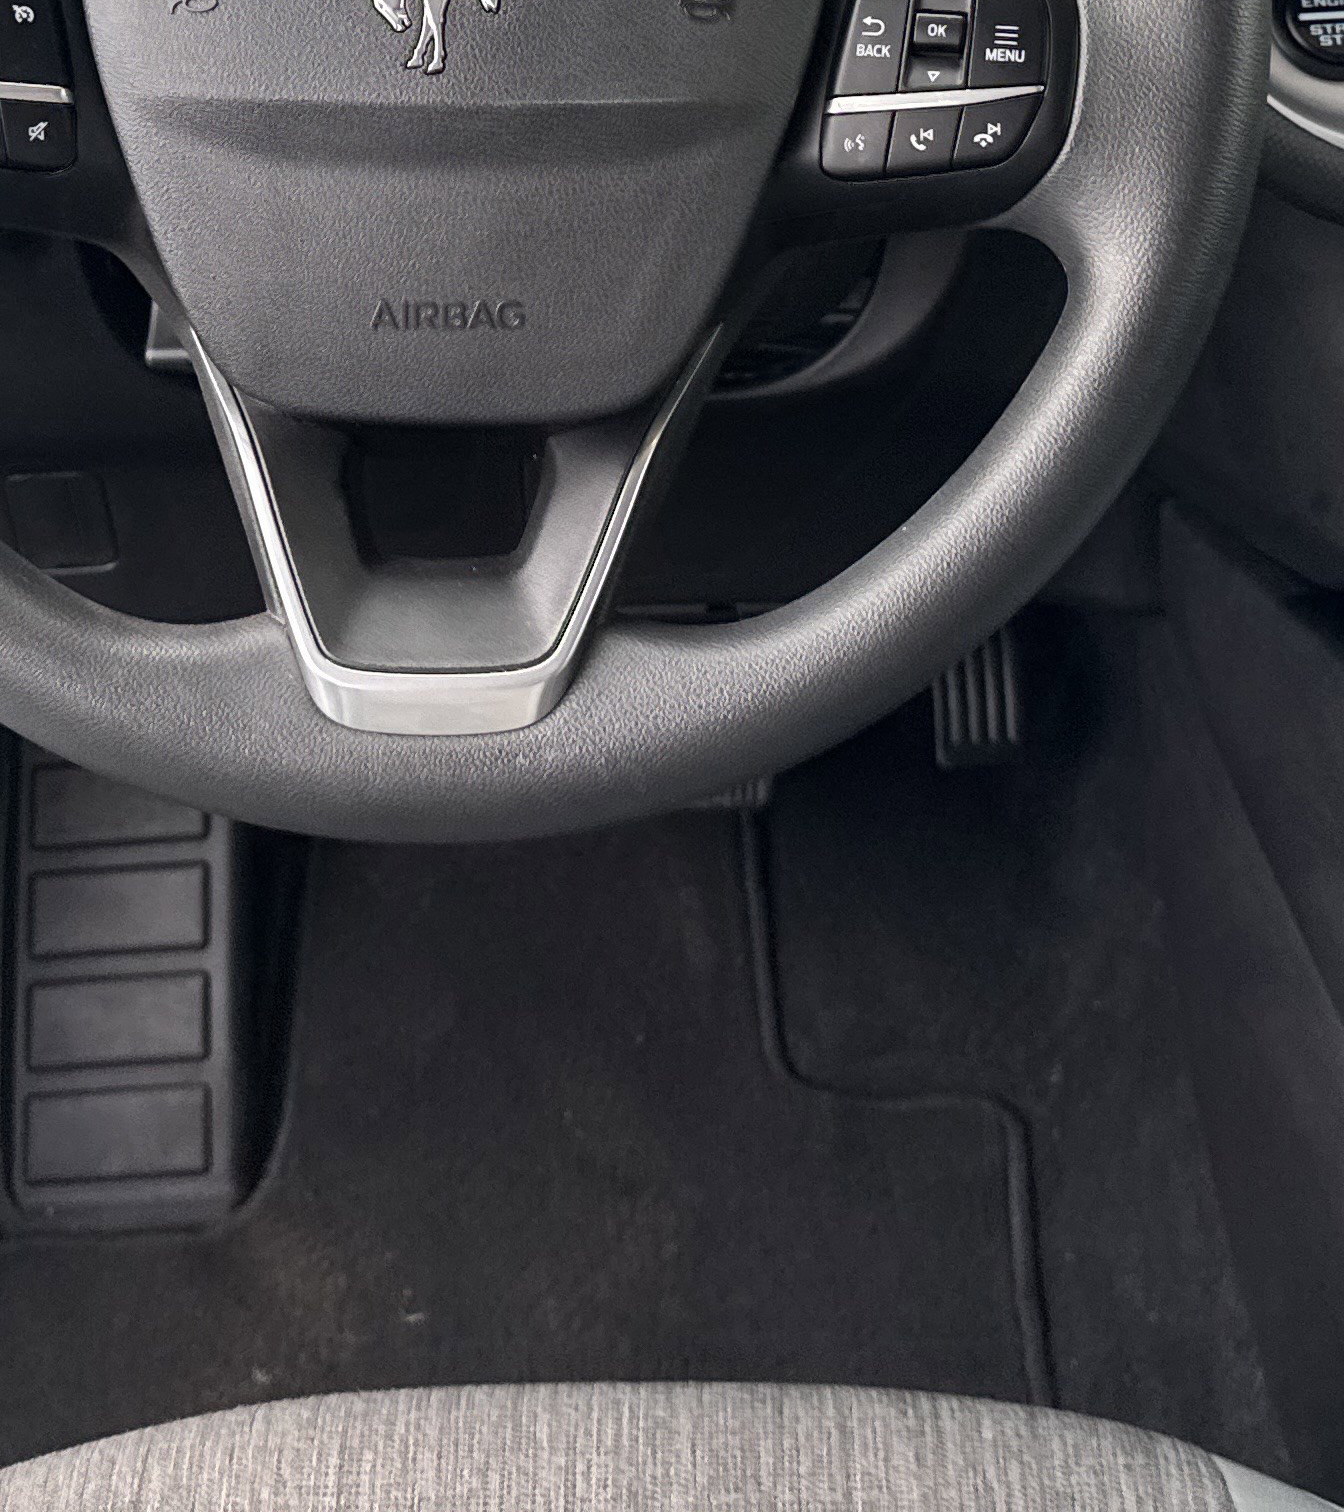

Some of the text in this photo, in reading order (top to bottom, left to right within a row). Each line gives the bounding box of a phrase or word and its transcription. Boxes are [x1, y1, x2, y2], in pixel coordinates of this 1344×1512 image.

[927, 24, 947, 38] OK
[856, 44, 891, 58] BACK
[985, 48, 1025, 63] MENU
[369, 298, 526, 331] AIRBAG
